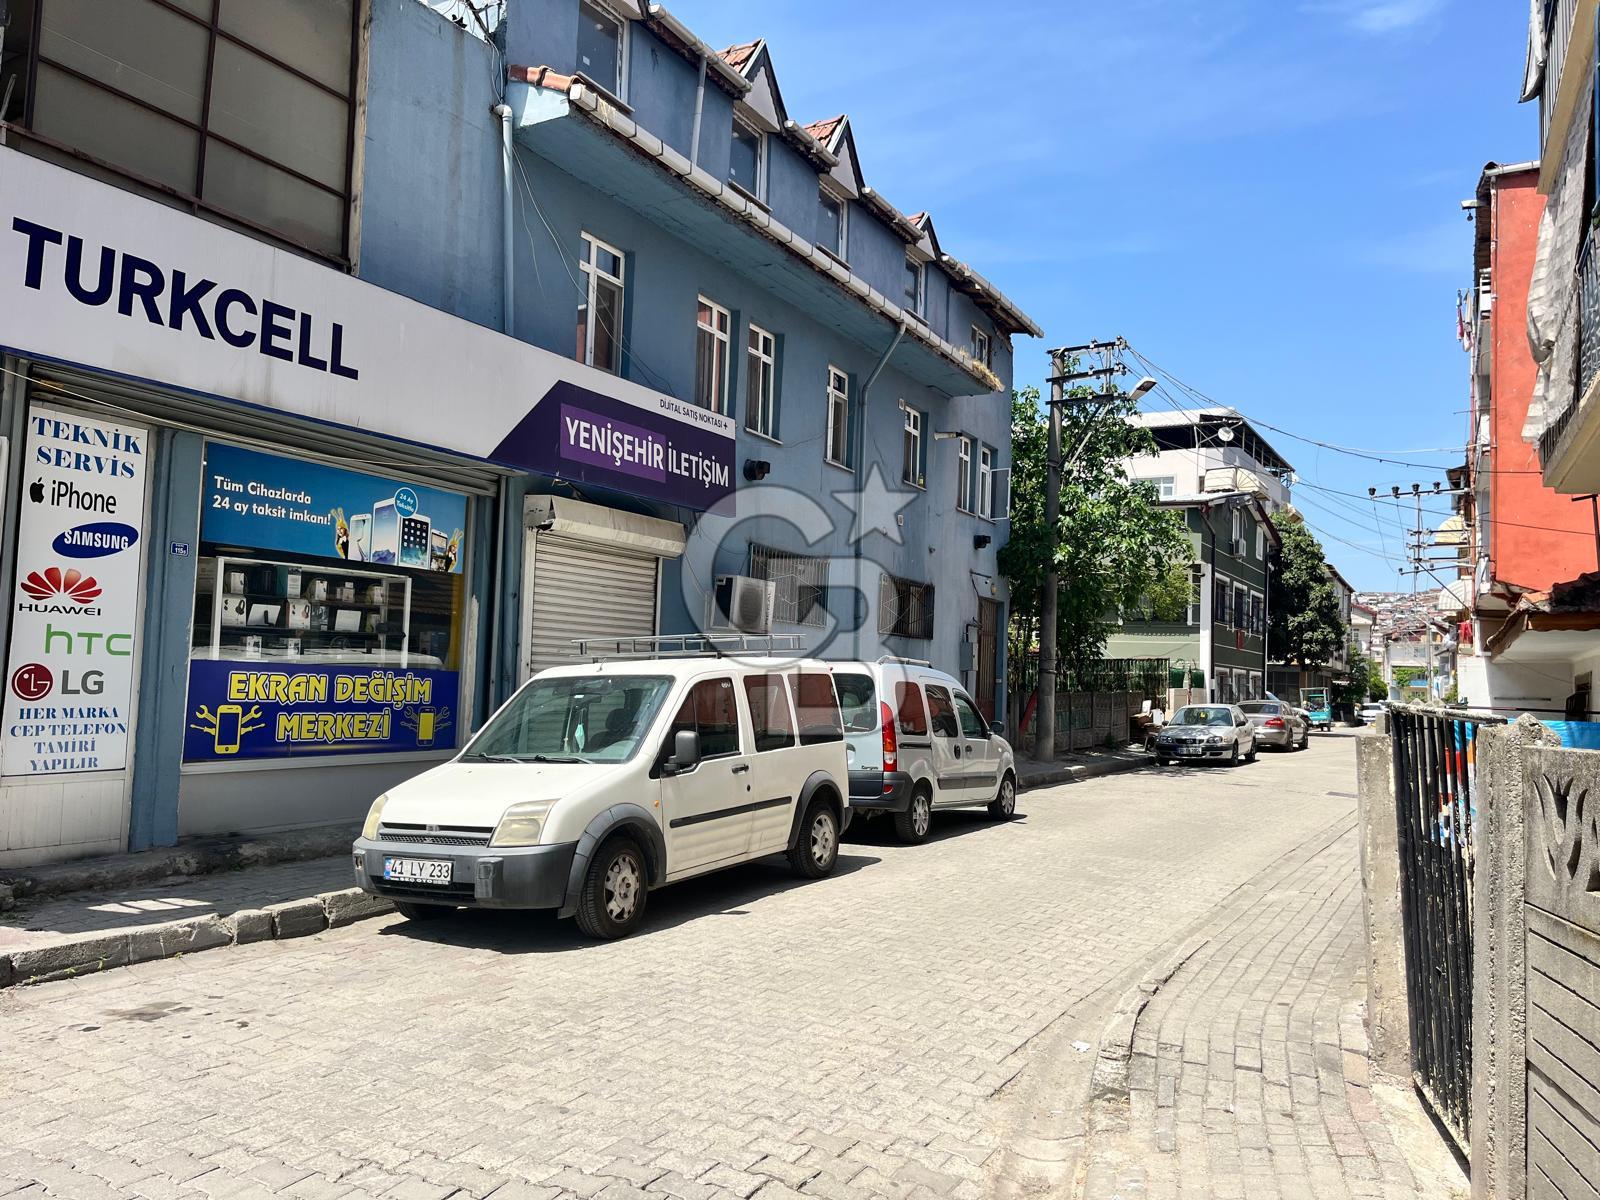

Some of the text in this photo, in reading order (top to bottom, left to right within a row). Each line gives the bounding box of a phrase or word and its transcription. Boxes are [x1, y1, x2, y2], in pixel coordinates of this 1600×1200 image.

[12, 216, 359, 381] TURKCELL
[683, 407, 698, 422] SATIŞ
[699, 413, 723, 428] NOKTASI
[32, 416, 142, 454] TEKNİK
[36, 445, 135, 479] SERVİS
[565, 416, 729, 488] YENİŞEHİR İLETİŞİM
[51, 480, 117, 514] iPhone
[214, 475, 312, 504] Tüm Cihazlarda
[212, 495, 331, 525] 24 ay taksit imkanı!
[64, 529, 129, 550] SAMSUNG
[19, 603, 101, 616] HUAWEI
[45, 623, 132, 657] htc
[61, 669, 104, 695] LG
[228, 670, 433, 709] EKRAN DEĞİŞİM
[19, 706, 119, 720] HER MARKA
[275, 709, 391, 743] MERKEZİ
[10, 722, 127, 737] CEP TELEFON
[34, 737, 96, 754] TAMİRİ
[30, 757, 98, 771] YAPILIR
[391, 859, 450, 878] 41 LY 233
